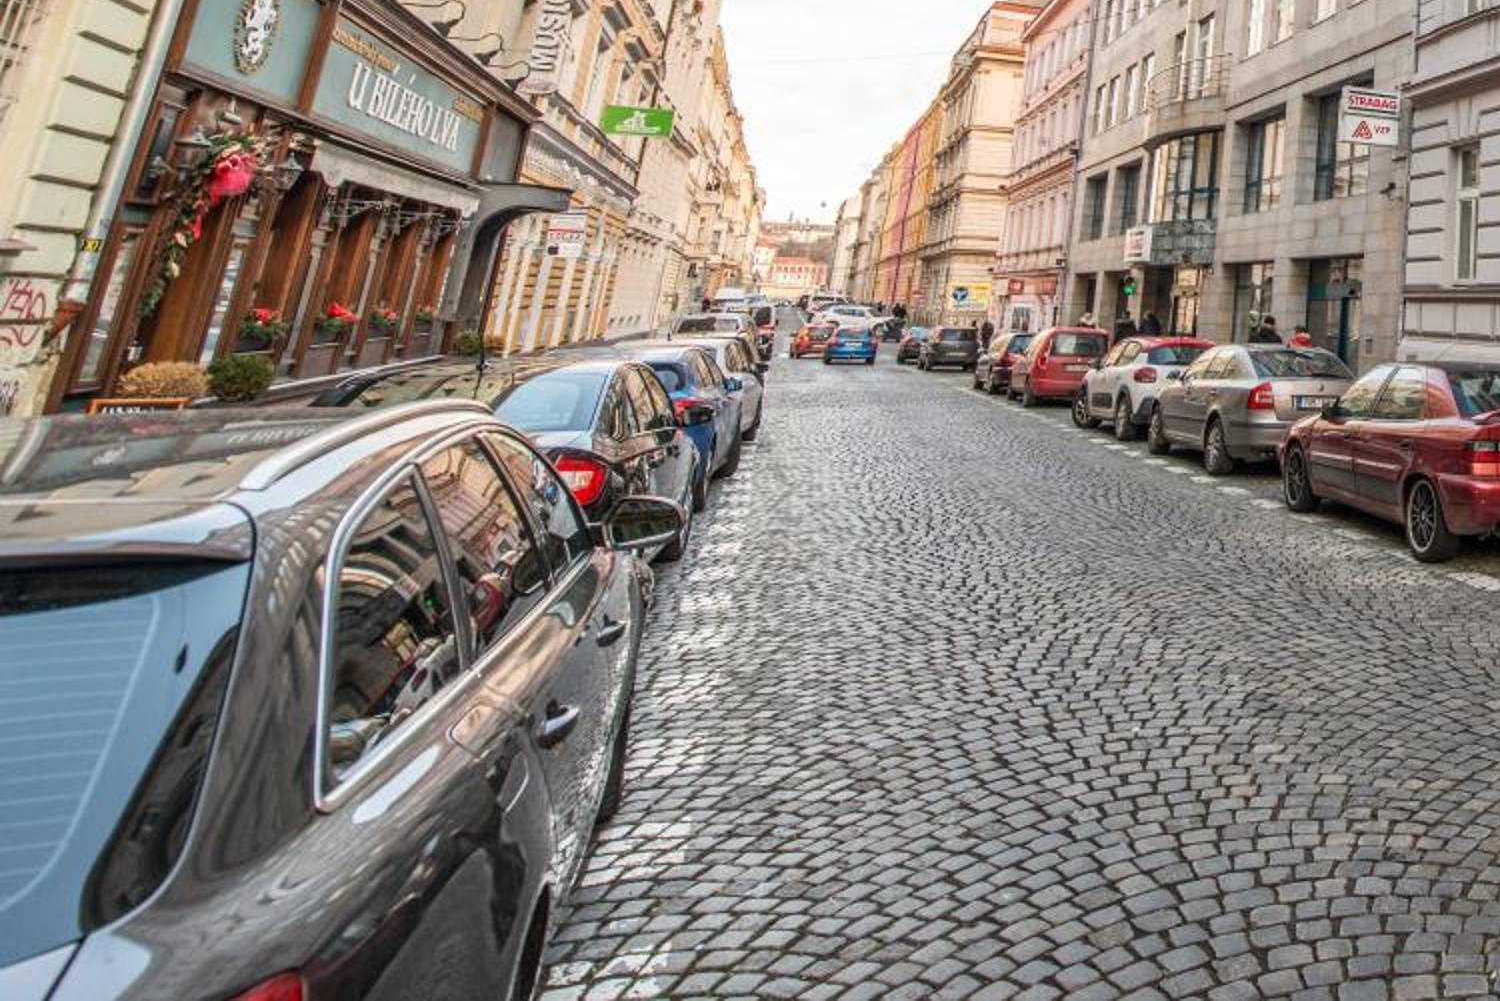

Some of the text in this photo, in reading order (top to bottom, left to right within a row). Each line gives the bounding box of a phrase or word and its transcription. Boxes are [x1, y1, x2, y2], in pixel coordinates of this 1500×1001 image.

[349, 62, 370, 110] U
[430, 105, 461, 151] LVA
[1349, 95, 1397, 109] STRABAG
